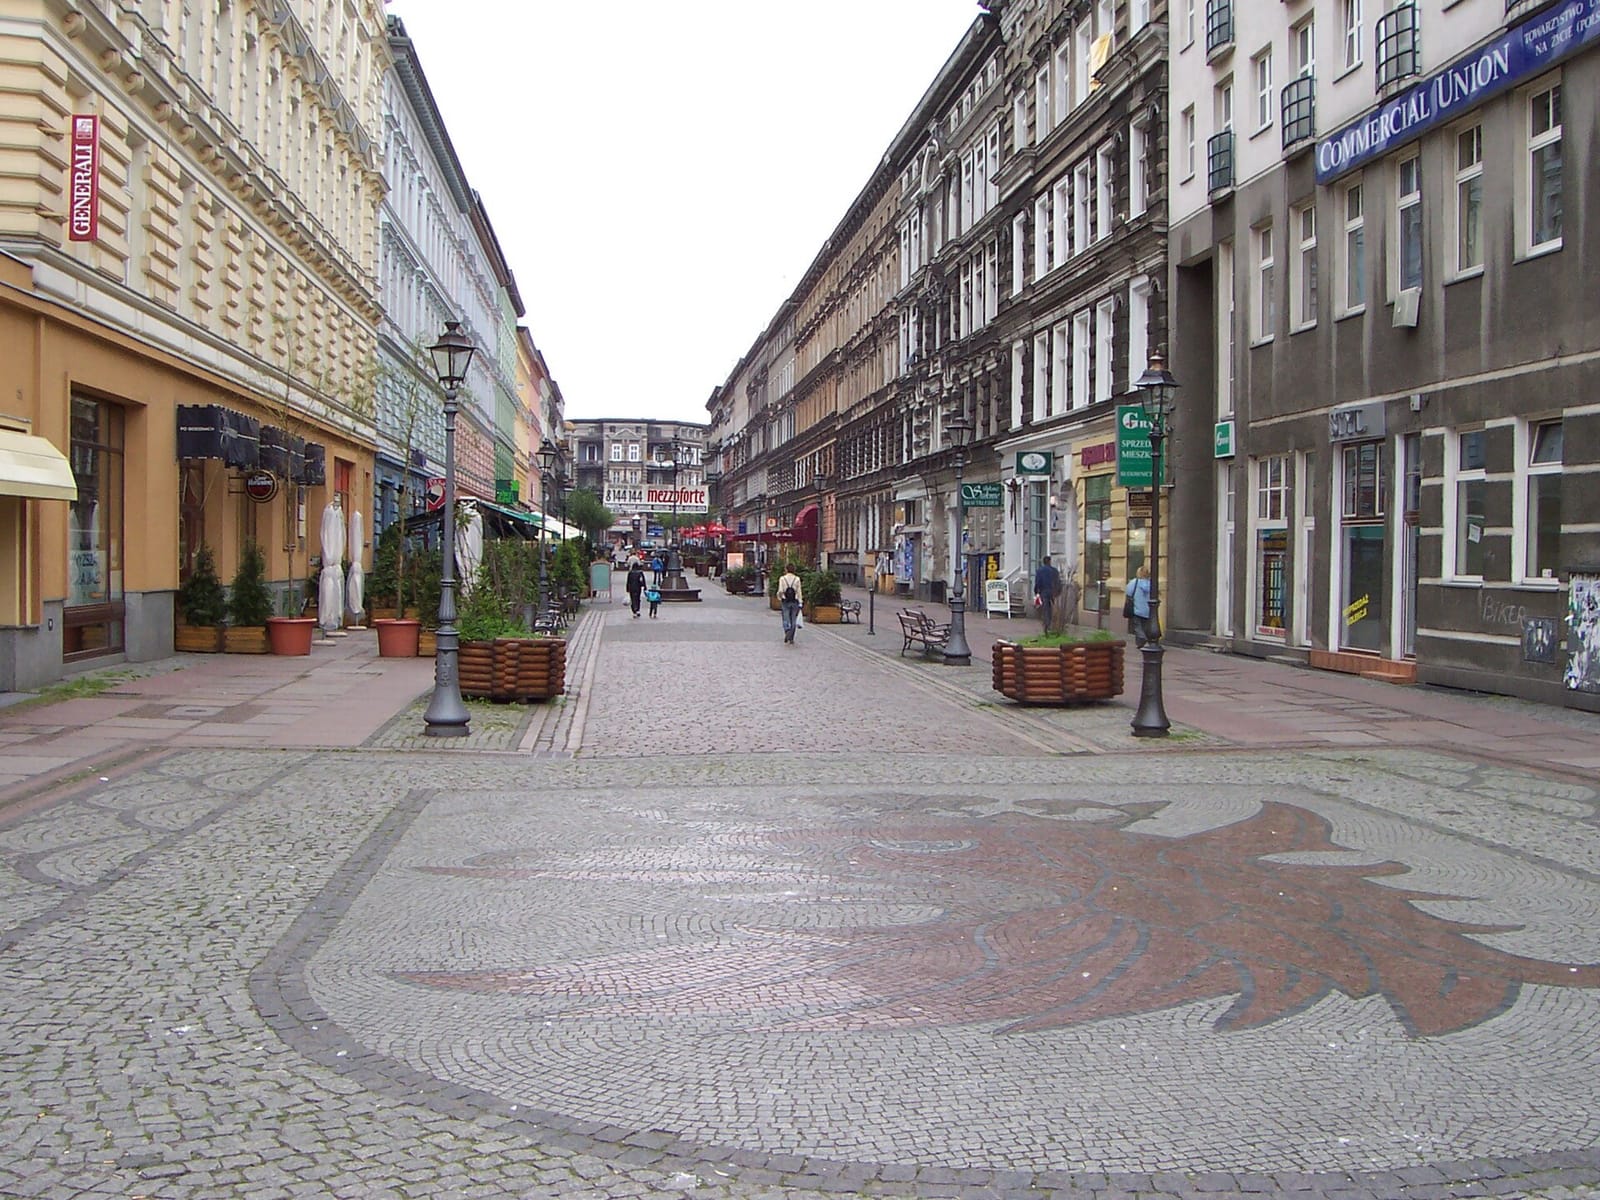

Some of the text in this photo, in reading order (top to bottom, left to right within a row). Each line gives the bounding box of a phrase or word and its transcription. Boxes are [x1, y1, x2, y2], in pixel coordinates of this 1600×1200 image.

[1535, 41, 1548, 56] NA
[1320, 43, 1510, 172] COMMERCIAL UNION
[73, 144, 92, 235] GENERALI
[1121, 440, 1152, 448] SPRZED
[1121, 450, 1153, 459] MIESZK
[647, 486, 705, 504] mezzoforte
